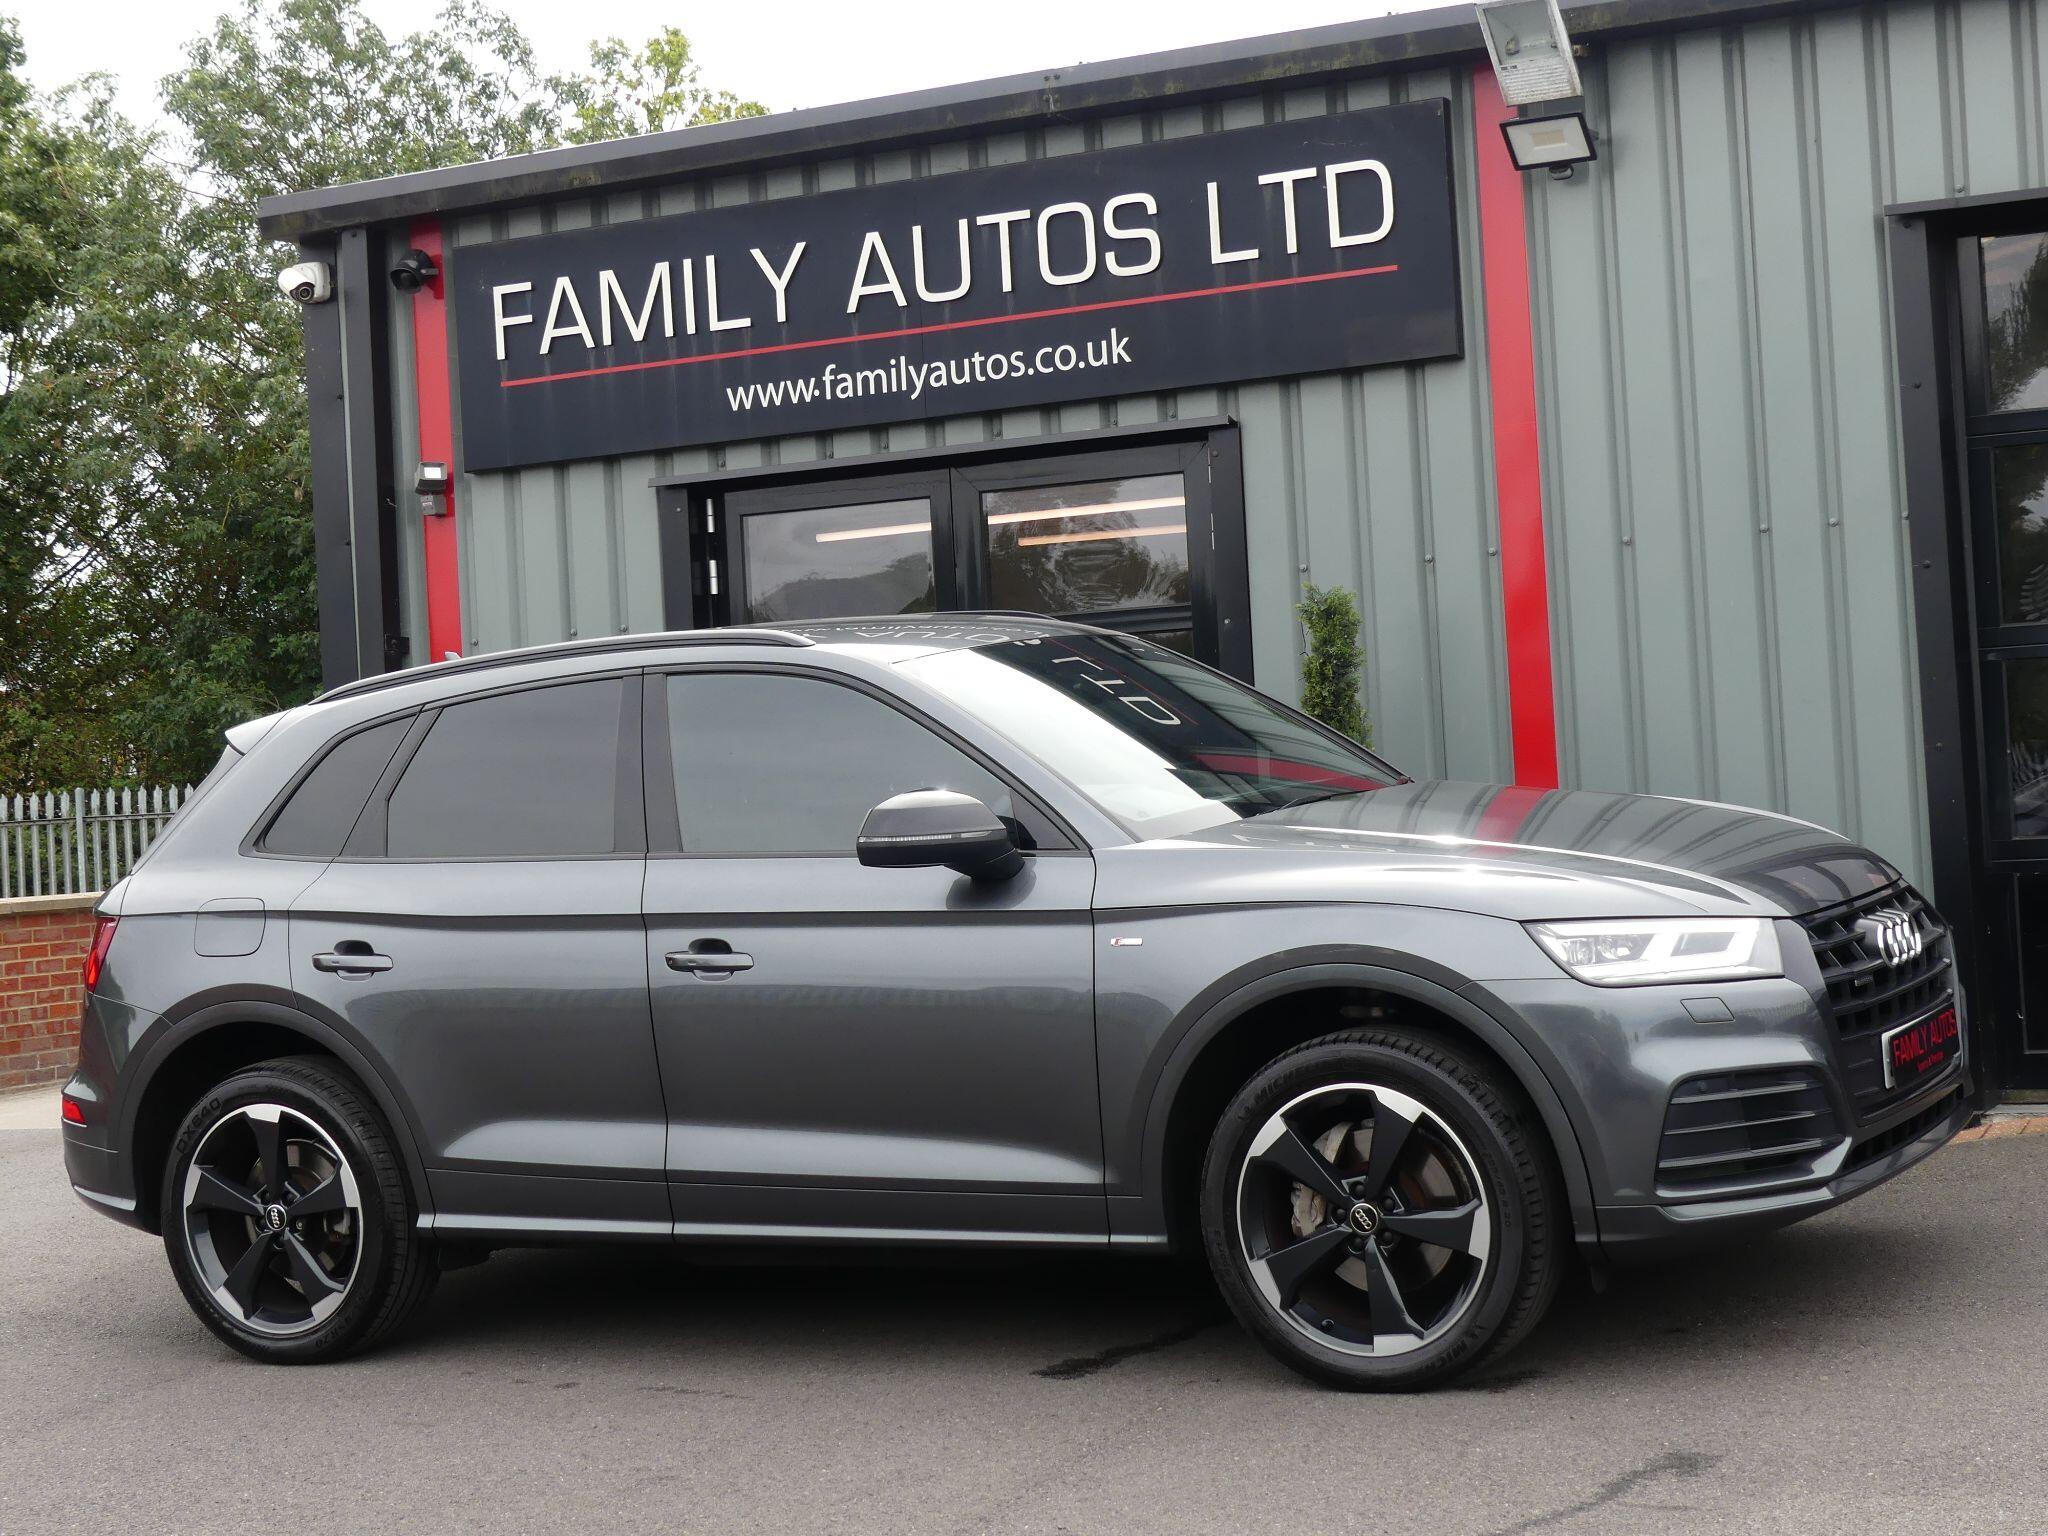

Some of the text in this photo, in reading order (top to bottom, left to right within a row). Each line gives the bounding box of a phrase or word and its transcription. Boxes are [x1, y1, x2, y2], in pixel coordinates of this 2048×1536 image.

[492, 159, 1395, 361] FAMILY AUTOS LTD
[725, 327, 1133, 412] www.familyautos.co.uk
[1892, 1024, 1927, 1067] FAMILY
[1930, 1008, 1957, 1047] AUTOS
